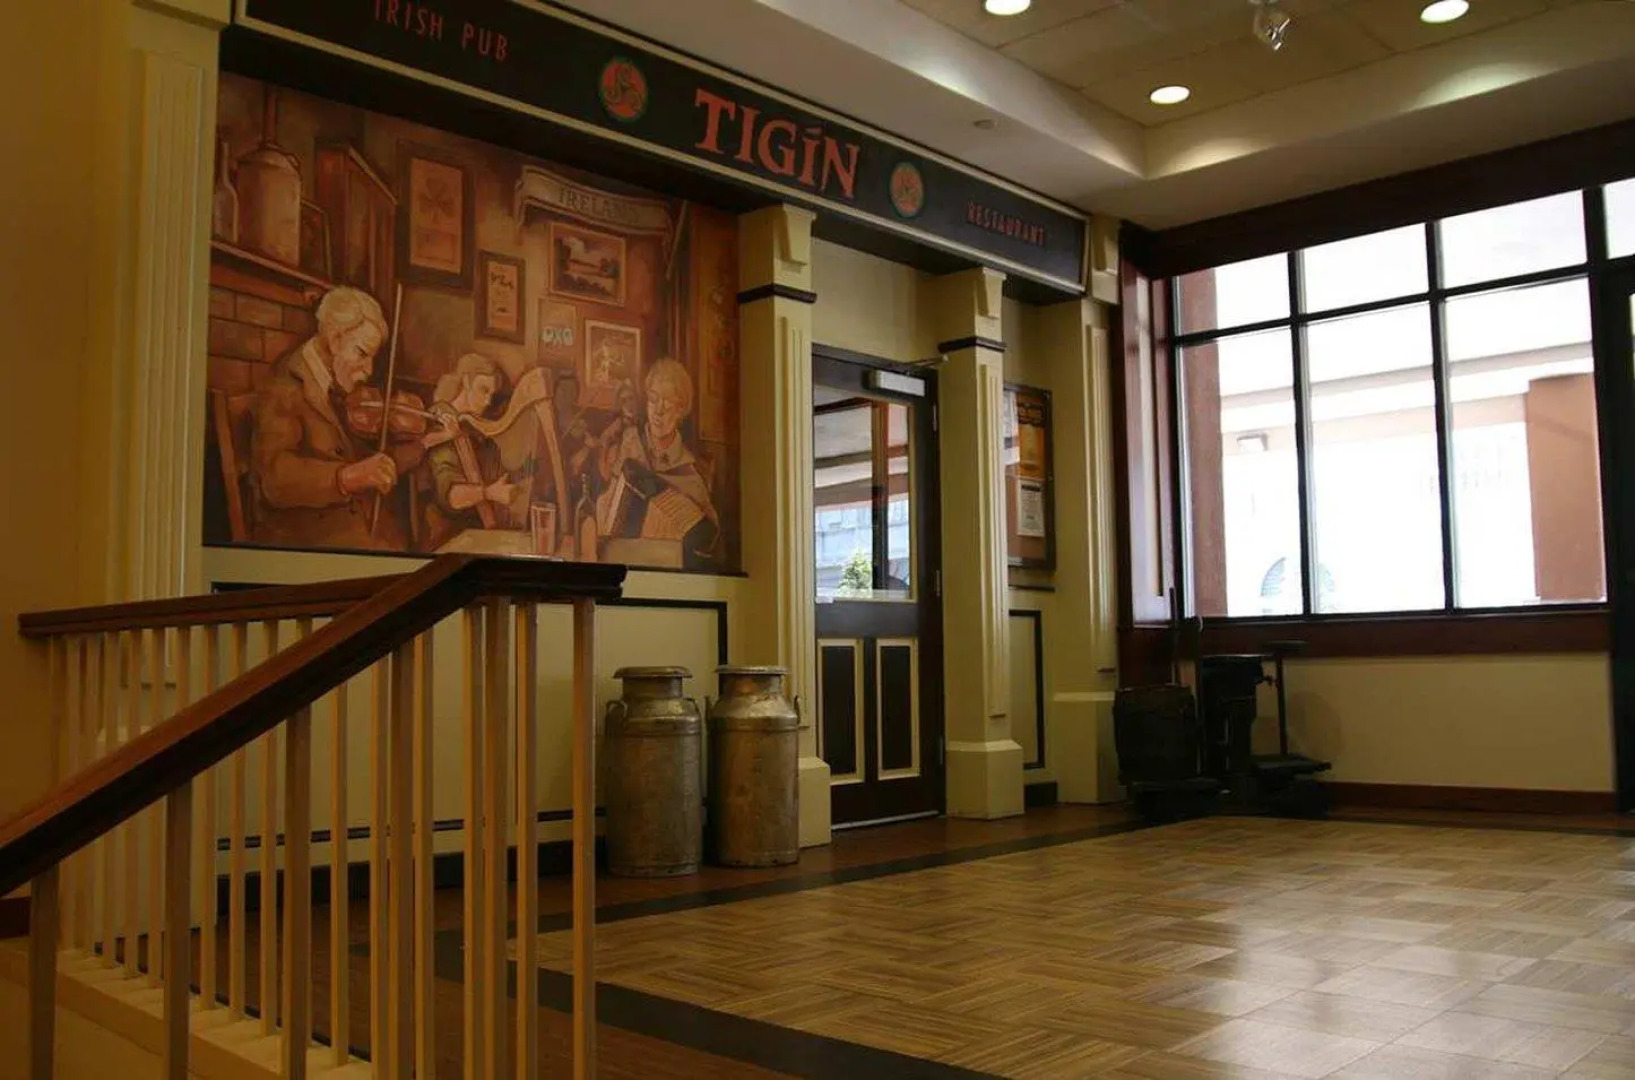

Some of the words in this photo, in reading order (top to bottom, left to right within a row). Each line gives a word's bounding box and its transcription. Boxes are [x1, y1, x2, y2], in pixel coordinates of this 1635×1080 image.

[375, 0, 443, 41] IRISH
[461, 20, 508, 62] PUB
[967, 201, 1044, 246] RESTAURANT
